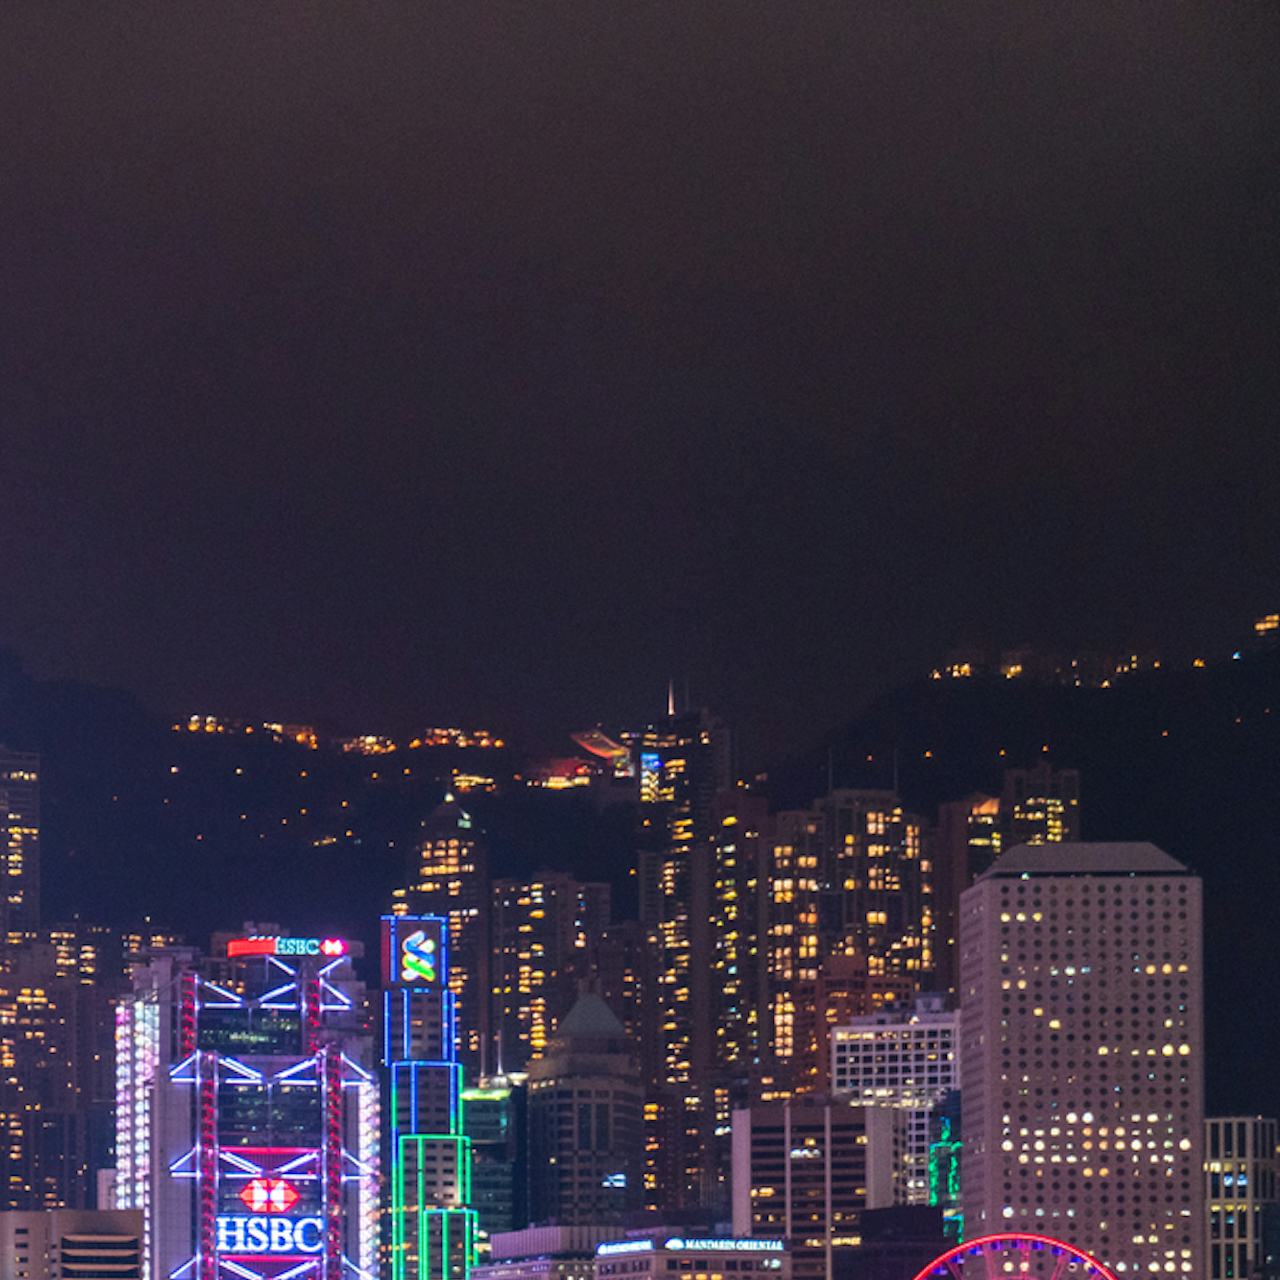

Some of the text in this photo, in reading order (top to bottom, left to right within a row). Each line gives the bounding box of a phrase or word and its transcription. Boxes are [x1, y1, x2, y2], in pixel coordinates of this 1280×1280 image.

[275, 937, 321, 956] HSBC
[215, 1217, 323, 1252] HSBC
[684, 1239, 784, 1251] MANDARIN ORIENTAL
